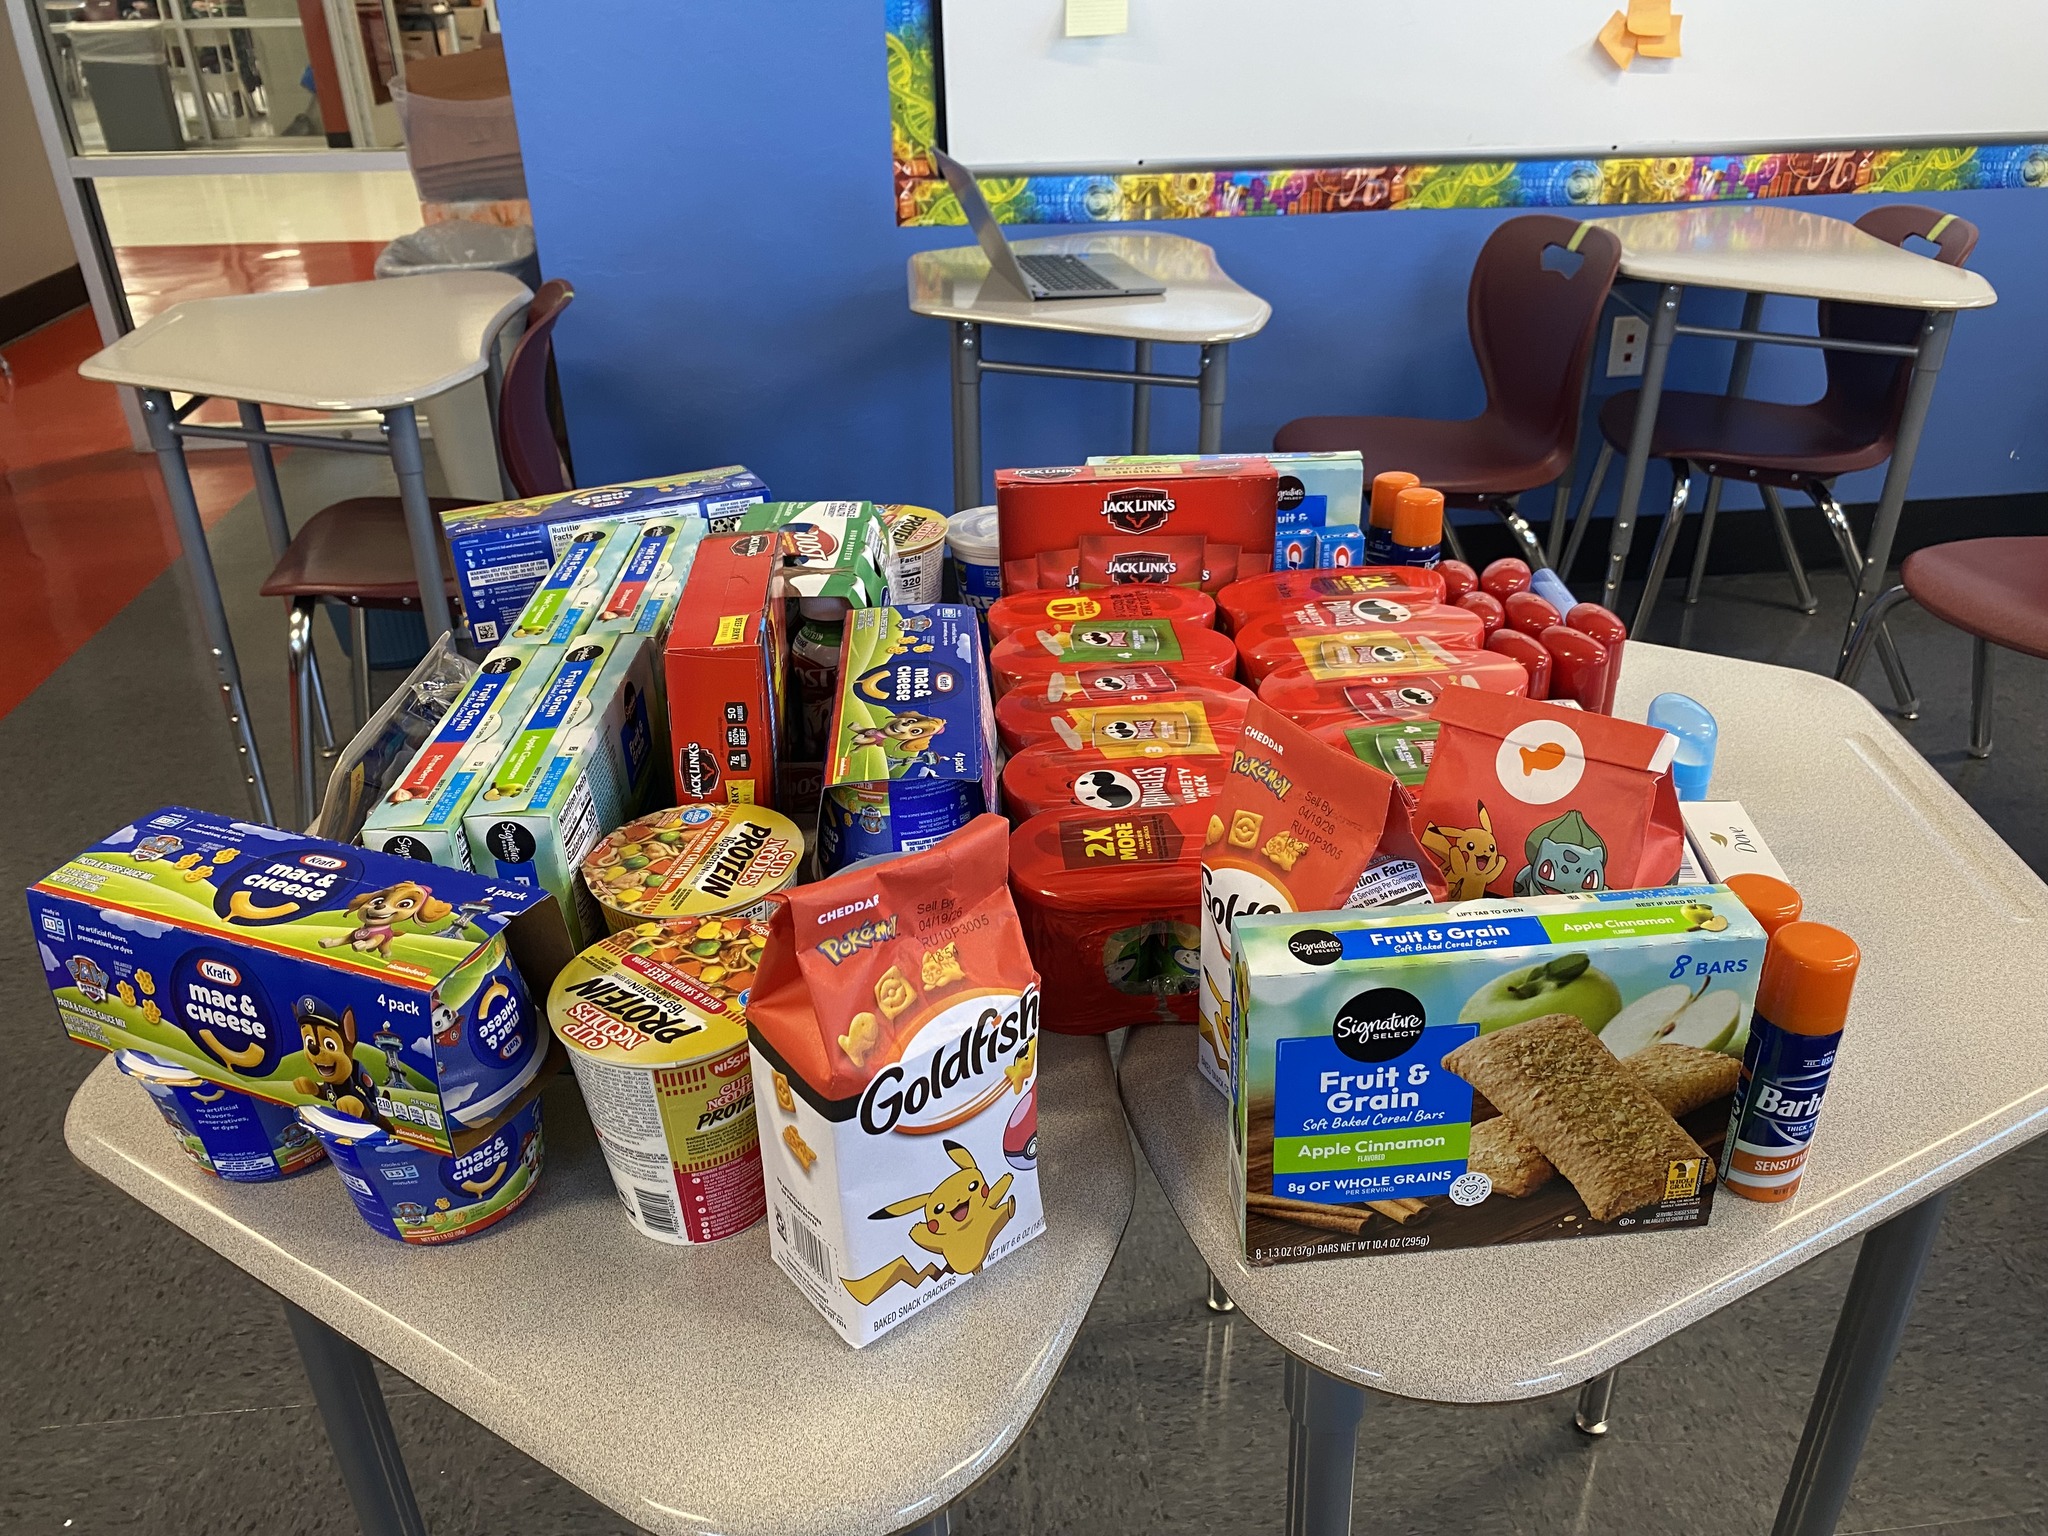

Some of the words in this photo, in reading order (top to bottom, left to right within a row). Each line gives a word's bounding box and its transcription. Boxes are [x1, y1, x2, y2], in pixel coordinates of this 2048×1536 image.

[1115, 468, 1163, 476] ORIGINAL
[1100, 499, 1136, 515] JACK
[1135, 498, 1176, 512] LINK'S
[554, 533, 573, 541] Facts
[893, 514, 927, 546] PROTEIN
[1106, 561, 1139, 575] JACK
[1138, 561, 1177, 574] LINK'S
[902, 576, 921, 587] 320
[1360, 576, 1390, 588] 2X
[616, 588, 634, 610] Strawberry
[1051, 603, 1077, 617] 10
[1303, 603, 1327, 627] VARIETY
[565, 670, 582, 689] Fruit
[914, 667, 931, 690] mac
[939, 675, 950, 688] Kraft
[476, 683, 498, 703] Fruit
[1366, 693, 1387, 712] ORIGINAL
[545, 694, 568, 718] Grain
[728, 707, 736, 719] 50
[455, 708, 481, 732] Grain
[1244, 725, 1284, 756] CHEDDAR
[508, 750, 531, 780] Cinnamon
[688, 742, 700, 773] LINK'S
[730, 755, 740, 766] 7g
[954, 757, 968, 773] pack
[1397, 738, 1409, 752] SOUR
[1404, 751, 1417, 769] CREAM
[413, 754, 444, 785] Strawberry
[691, 774, 703, 799] JACK
[1132, 767, 1176, 808] PRINGLES
[1177, 768, 1198, 804] VARIETY
[1194, 775, 1211, 798] PACK
[558, 795, 577, 826] Nutrition
[575, 774, 587, 797] Facts
[1304, 790, 1320, 807] Sell
[567, 828, 586, 860] Calories
[584, 804, 596, 826] 130
[1298, 806, 1336, 835] 04/19/26
[499, 823, 520, 863] Signature
[1082, 827, 1116, 858] 2X
[1115, 822, 1138, 861] MORE
[1290, 820, 1343, 860] RU10P3005
[1729, 826, 1757, 853] Dove
[308, 856, 337, 868] Kraft
[673, 851, 700, 879] CHICKEN
[701, 821, 772, 899] PROTEIN
[737, 837, 791, 887] NOODLES
[770, 849, 797, 878] CUP
[1382, 862, 1416, 877] Facts
[264, 863, 316, 883] mac
[495, 888, 528, 902] pack
[1357, 886, 1382, 900] Servings
[1382, 882, 1392, 890] Per
[1393, 872, 1418, 886] Container
[1388, 887, 1408, 897] Pieces
[817, 893, 880, 925] CHEDDAR
[1502, 907, 1524, 915] OPEN
[1664, 899, 1685, 907] USED
[86, 926, 107, 937] artificial
[107, 932, 128, 944] flavors,
[921, 914, 989, 947] RU10P3005
[1369, 930, 1423, 946] Fruit
[1427, 928, 1443, 941] &
[1446, 924, 1510, 938] Grain
[1563, 920, 1604, 934] Apple
[1605, 915, 1675, 928] Cinnamon
[1289, 940, 1341, 955] Signature
[1394, 944, 1413, 954] Soft
[1415, 940, 1443, 952] Baked
[1445, 939, 1472, 950] Cereal
[1475, 938, 1498, 947] Bars
[204, 963, 233, 982] Kraft
[643, 966, 672, 983] BEEF
[1668, 954, 1692, 980] 8
[1695, 958, 1749, 977] BARS
[666, 977, 698, 995] SAVORY
[188, 983, 237, 1011] mac
[240, 995, 257, 1018] &
[377, 993, 386, 1006] 4
[388, 998, 420, 1016] pack
[565, 977, 702, 1044] PROTEIN
[699, 996, 722, 1010] RICH
[562, 1023, 610, 1049] CUP
[569, 1002, 649, 1050] NOODLES
[1337, 1011, 1422, 1044] Signature
[1372, 1030, 1421, 1040] SELECT
[859, 990, 1039, 1136] Goldfish
[1821, 1057, 1834, 1066] USA
[719, 1073, 751, 1096] CUP
[1320, 1067, 1400, 1093] Fruit
[1407, 1063, 1430, 1086] &
[377, 1098, 390, 1109] 210
[1326, 1087, 1419, 1114] Grain
[1302, 1118, 1328, 1132] Soft
[1332, 1117, 1369, 1129] Baked
[1372, 1112, 1413, 1126] Cereal
[1414, 1109, 1445, 1121] Bars
[454, 1144, 493, 1170] mac
[1298, 1142, 1351, 1159] Apple
[1354, 1135, 1445, 1153] Cinnamon
[1357, 1153, 1385, 1163] FLAVORED
[1288, 1182, 1306, 1194] 8g
[1309, 1181, 1331, 1191] OF
[1334, 1174, 1390, 1190] WHOLE
[1394, 1170, 1452, 1185] GRAINS
[1345, 1188, 1360, 1196] PER
[1361, 1186, 1395, 1194] SERVING
[1456, 1176, 1476, 1187] LOVE
[987, 1247, 1000, 1263] NET
[1255, 1250, 1262, 1260] 8
[1268, 1248, 1279, 1258] 1.3
[1280, 1247, 1292, 1257] OZ
[1293, 1245, 1316, 1257] (37g)
[1317, 1244, 1339, 1255] BARS
[1340, 1242, 1356, 1252] NET
[1357, 1241, 1371, 1251] WT
[1372, 1239, 1388, 1250] 10.4
[1389, 1238, 1401, 1249] OZ
[1402, 1234, 1430, 1248] (295g)
[873, 1310, 897, 1332] BAKED
[898, 1296, 921, 1318] SNACK
[922, 1275, 956, 1306] CRACKERS
